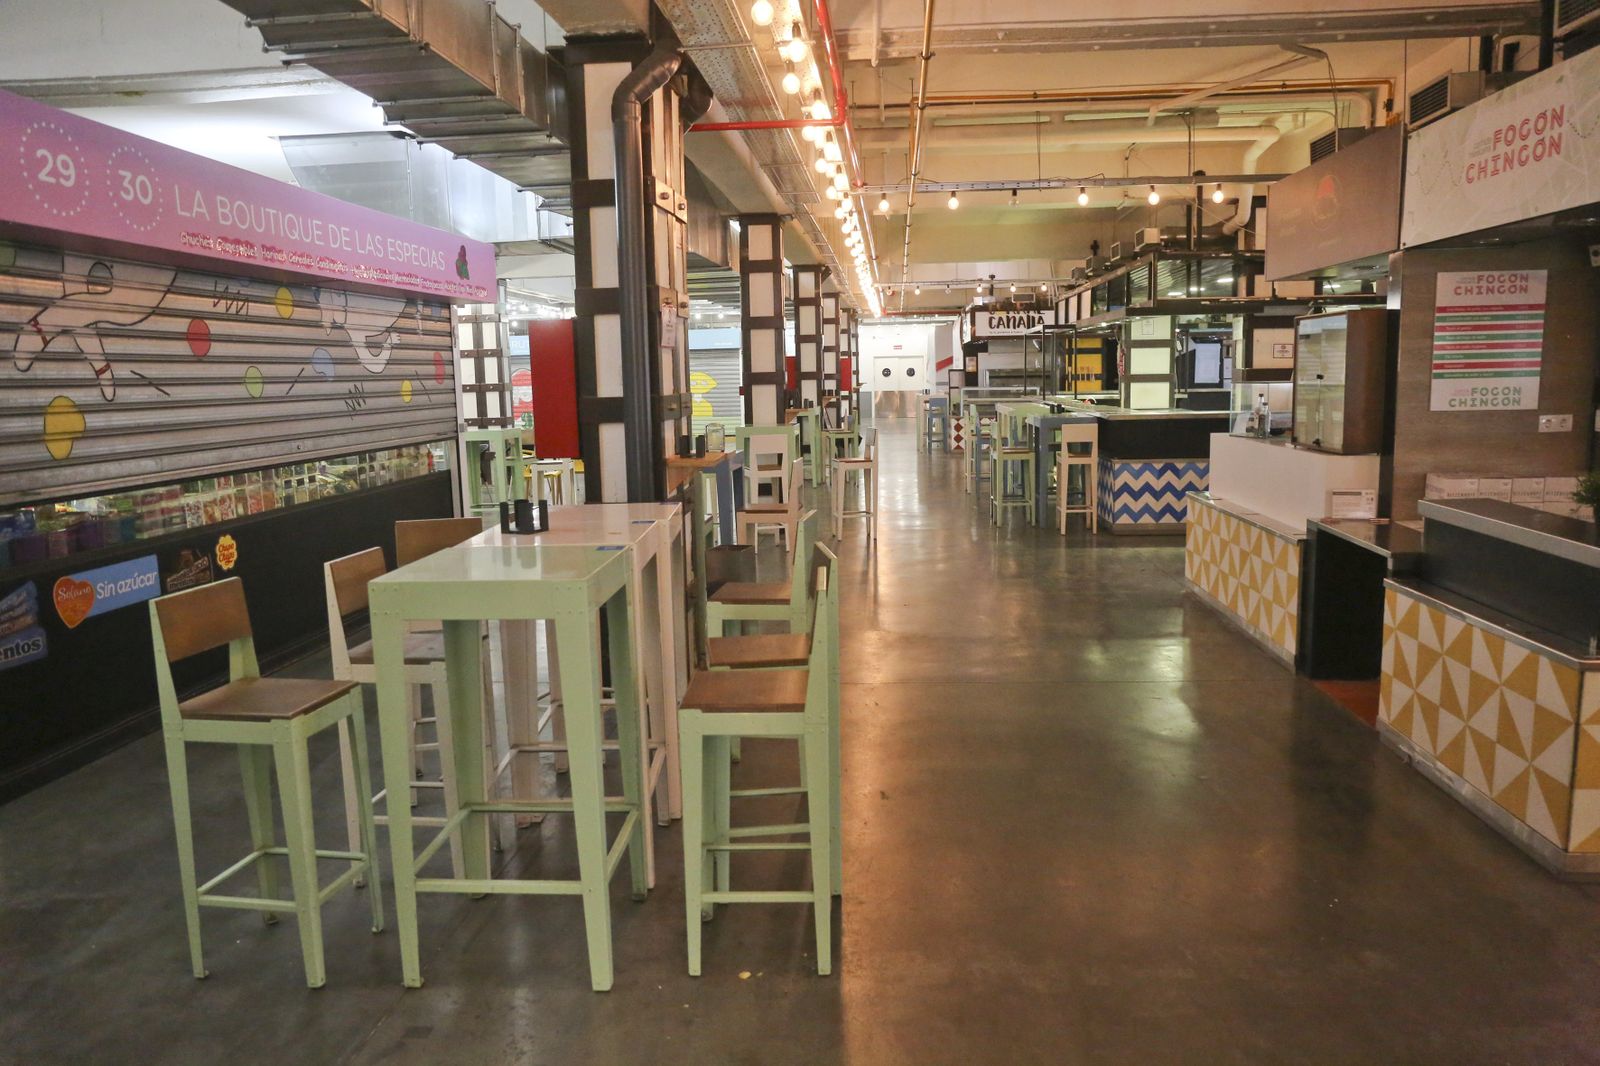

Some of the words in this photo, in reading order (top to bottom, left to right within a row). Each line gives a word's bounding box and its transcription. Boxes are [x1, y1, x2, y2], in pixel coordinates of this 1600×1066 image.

[36, 149, 76, 187] 29
[118, 170, 153, 205] 30
[175, 184, 210, 221] LA
[216, 196, 324, 245] BOUTIQUE
[328, 224, 352, 251] DE
[355, 230, 384, 259] LAS
[387, 238, 446, 271] ESPECIAS
[96, 581, 116, 600] Sin
[118, 571, 159, 594] azúcar
